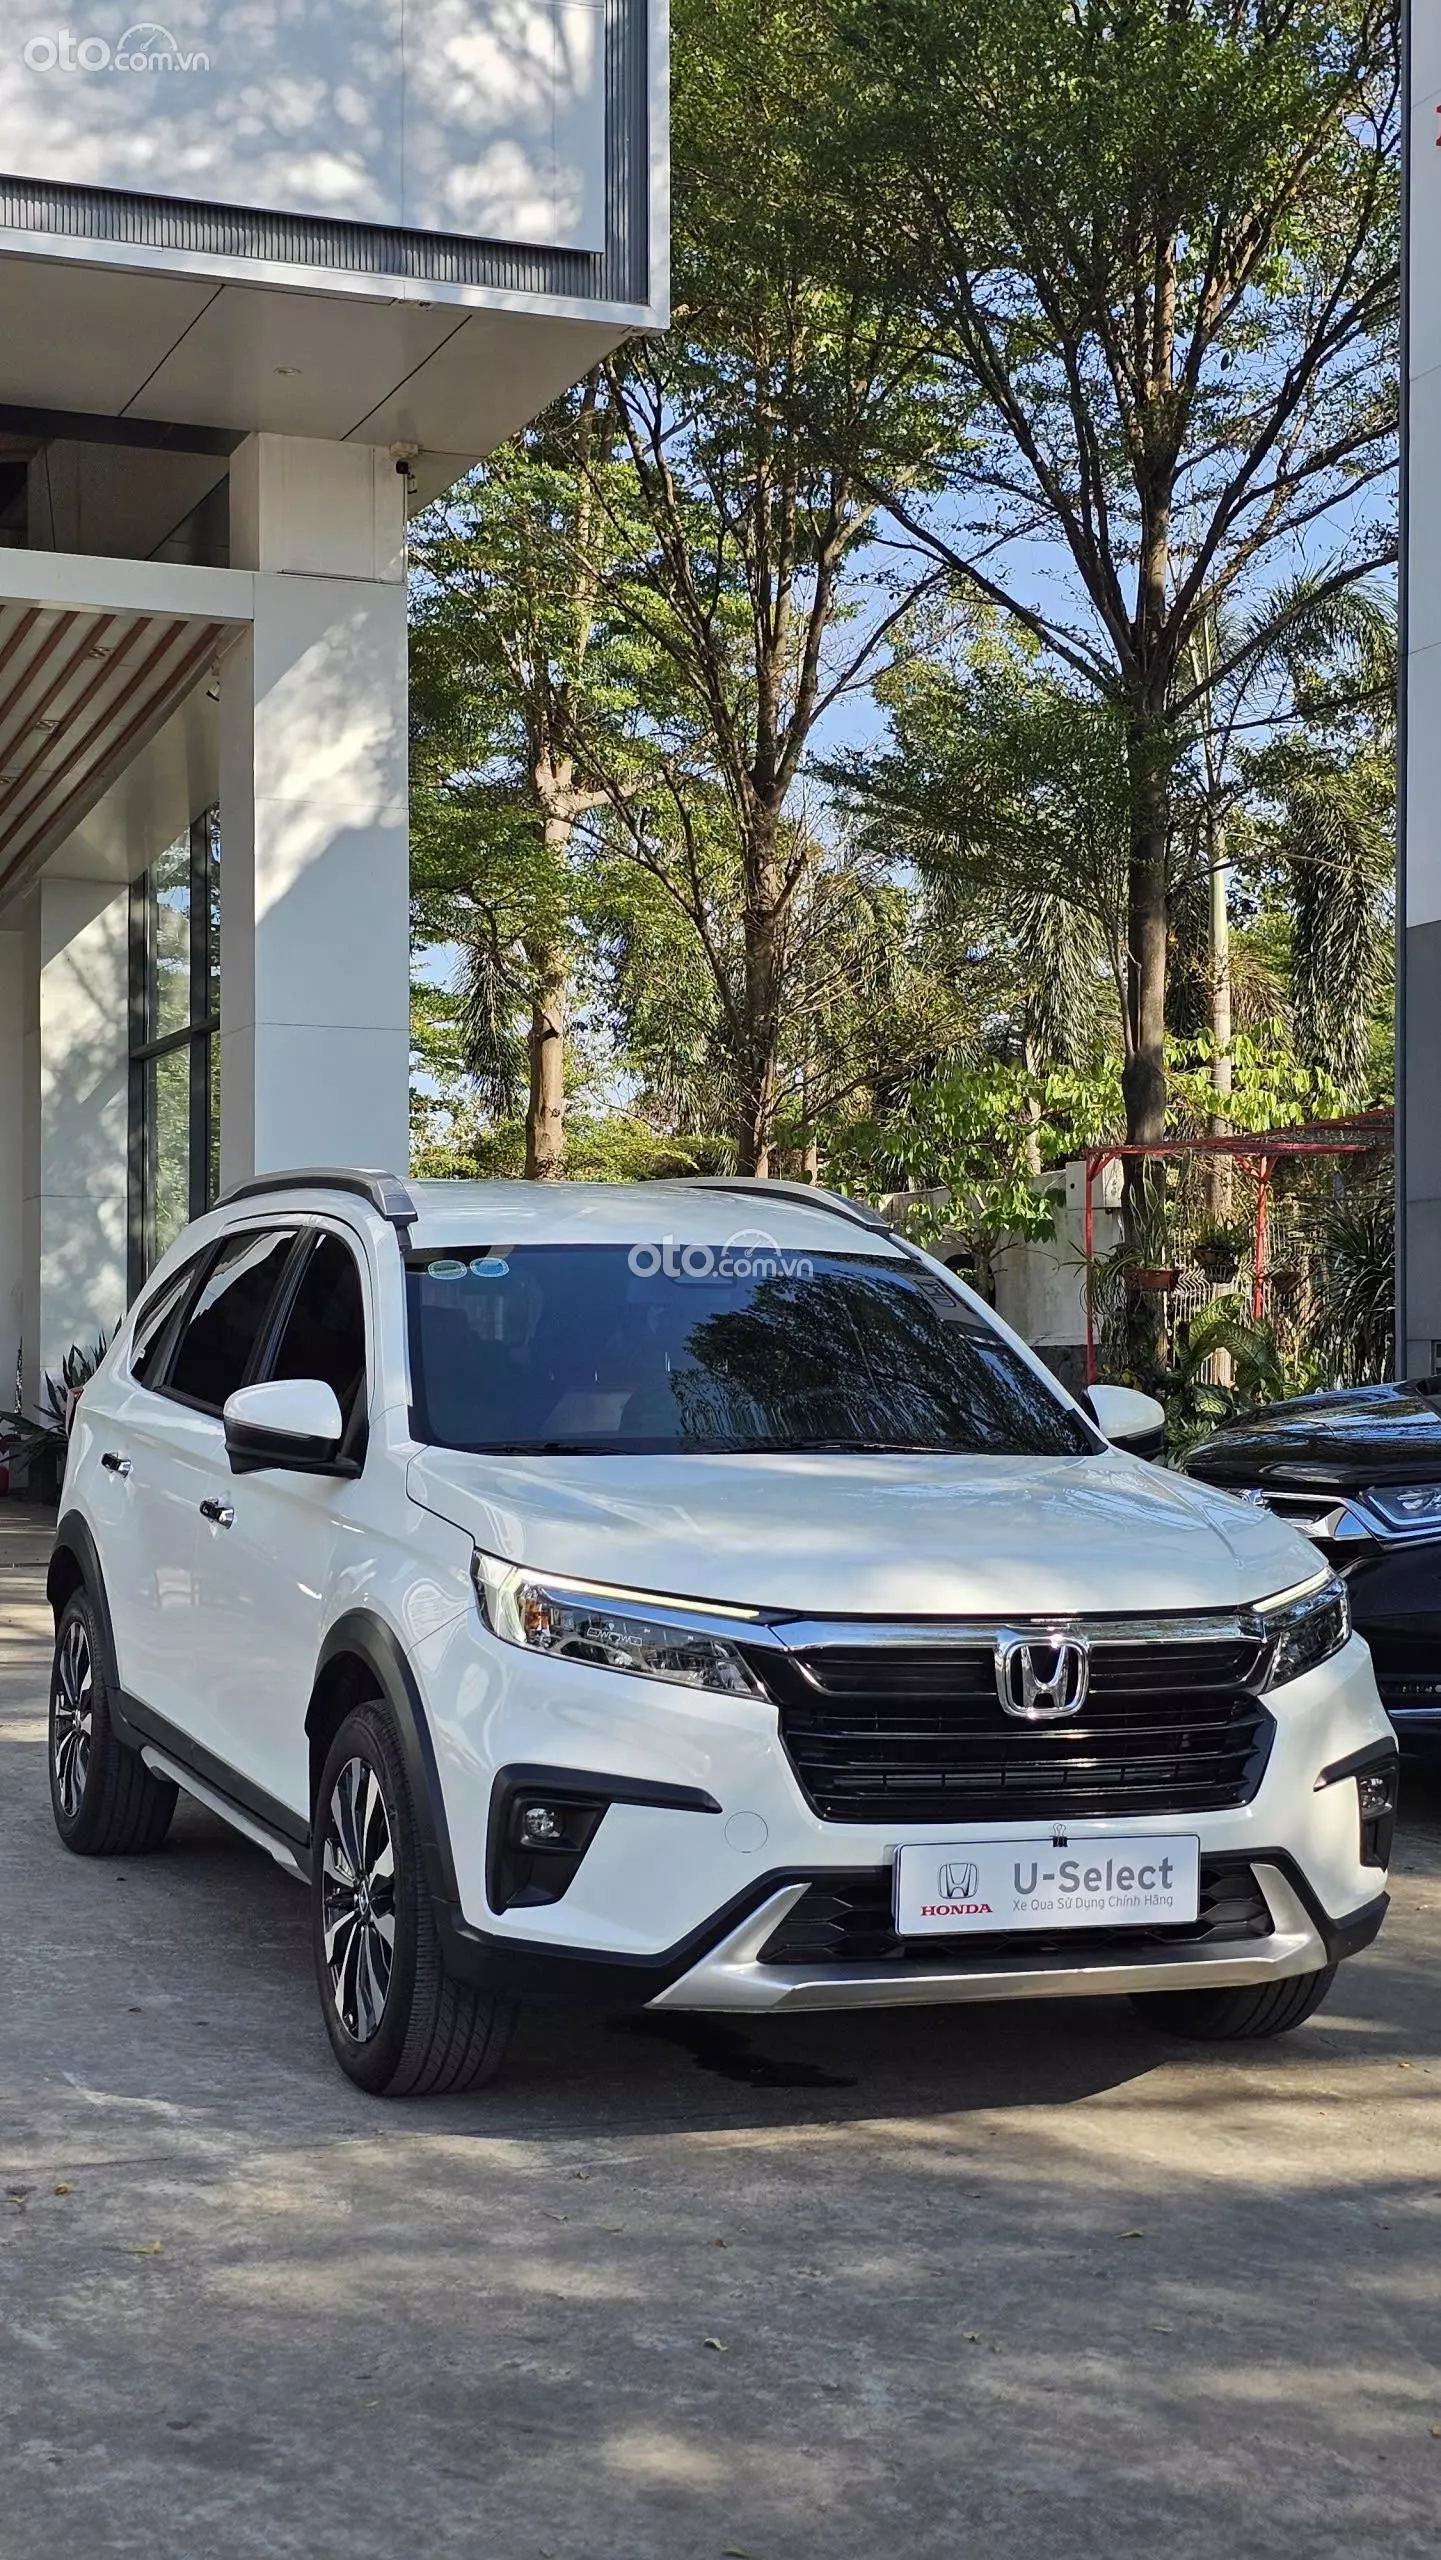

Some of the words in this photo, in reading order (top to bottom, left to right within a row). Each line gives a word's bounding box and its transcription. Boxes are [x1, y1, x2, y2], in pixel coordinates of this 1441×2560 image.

[1014, 1857, 1174, 1895] U-Select
[920, 1903, 993, 1917] HONDA
[1012, 1899, 1028, 1912] Xe
[1030, 1898, 1054, 1911] Qua
[1075, 1896, 1105, 1910] Dụng
[1108, 1894, 1141, 1908] Chính
